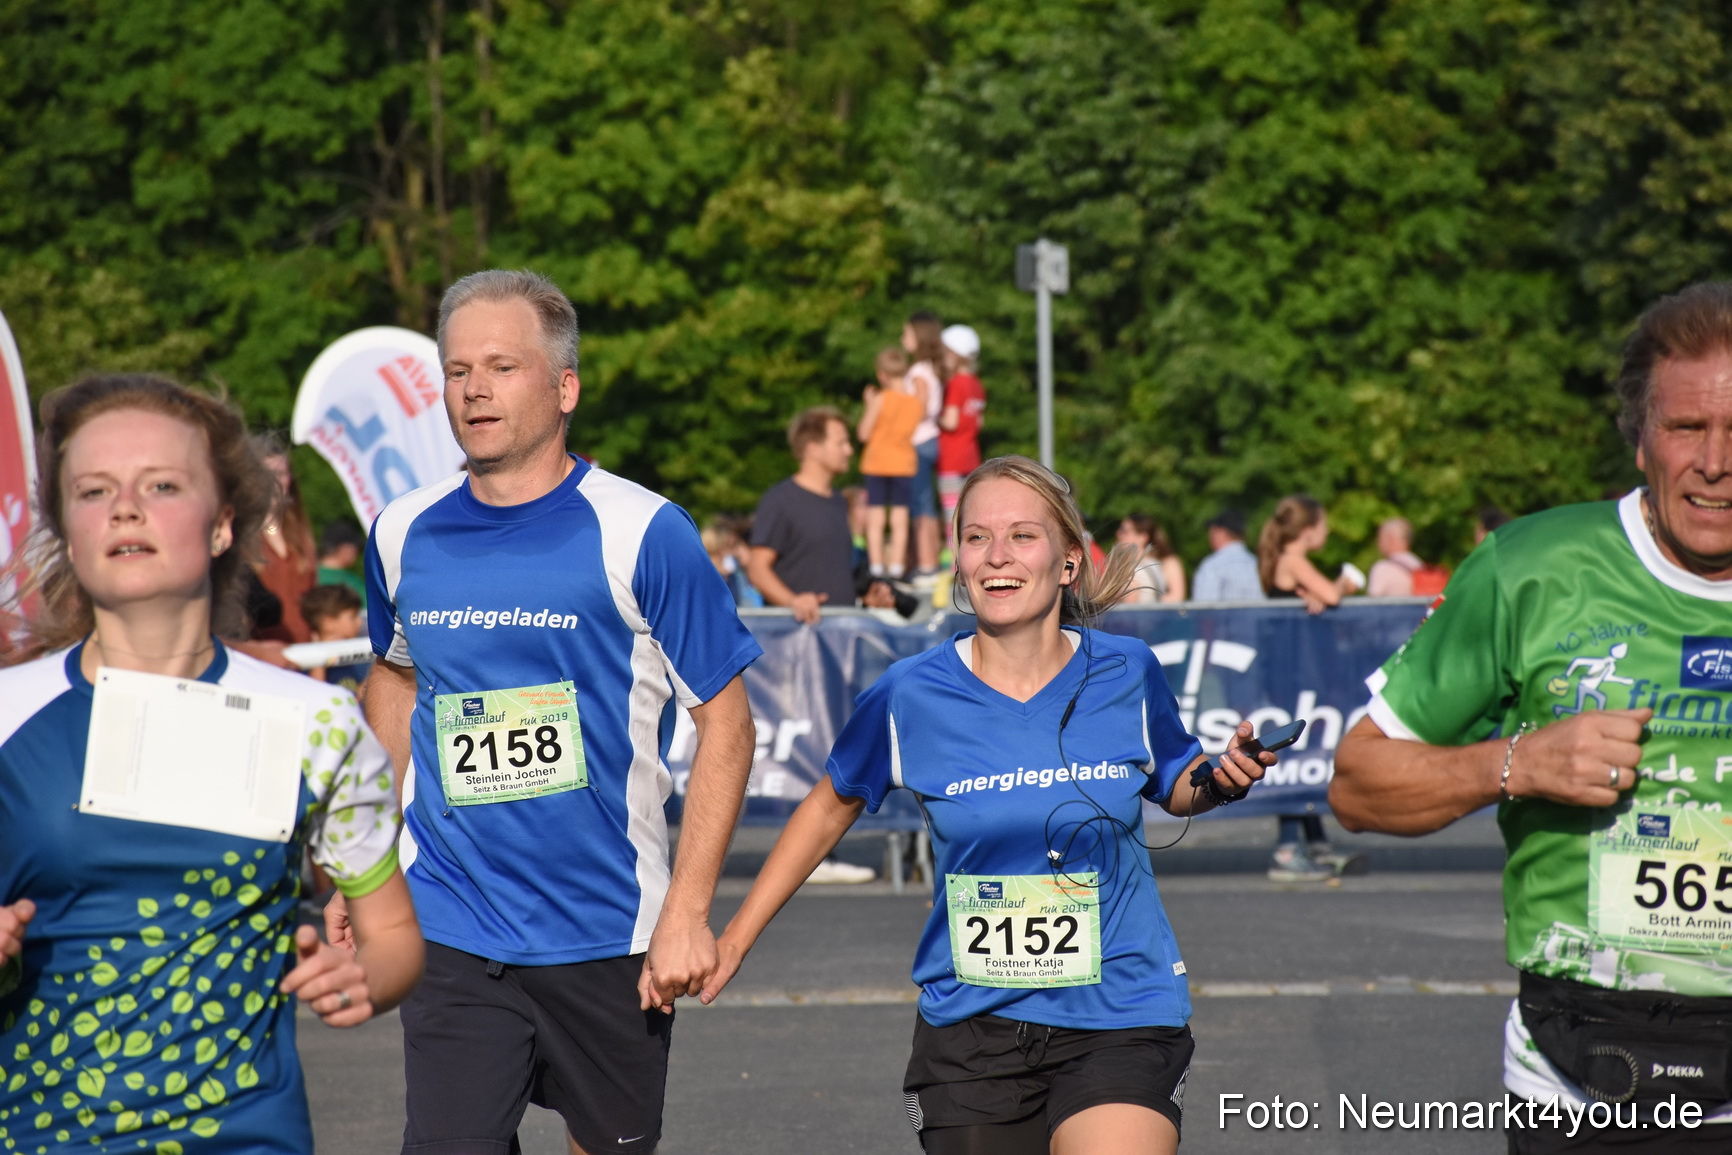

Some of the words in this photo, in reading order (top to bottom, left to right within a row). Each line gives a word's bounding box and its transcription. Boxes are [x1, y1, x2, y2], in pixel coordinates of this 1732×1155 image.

[410, 606, 578, 630] energiegeladen
[1628, 679, 1732, 722] firm
[454, 711, 507, 727] firmenlauf
[541, 712, 568, 724] 2019
[1181, 691, 1367, 755] isch
[453, 725, 562, 774] 2158
[465, 772, 512, 785] Steinlein
[514, 767, 557, 780] Jochen
[1639, 754, 1698, 782] nde
[473, 785, 490, 794] Seitz
[492, 784, 498, 792] &
[500, 782, 523, 791] Braun
[525, 778, 550, 788] GmbH
[945, 761, 1129, 796] energiegeladen
[1621, 832, 1700, 852] firmenlauf
[968, 897, 1026, 908] firmenlauf
[1062, 903, 1089, 914] 2019
[1648, 913, 1680, 927] Bott
[1685, 916, 1732, 930] Armin
[966, 915, 1079, 955] 2152
[1629, 926, 1658, 937] Dekra
[1661, 929, 1715, 941] Automobil
[985, 957, 1031, 968] Foistner
[1034, 958, 1064, 970] Katja
[986, 969, 1003, 977] Seitz
[1013, 969, 1037, 977] Braun
[1038, 969, 1063, 977] GmbH
[1667, 1066, 1704, 1078] DEKRA
